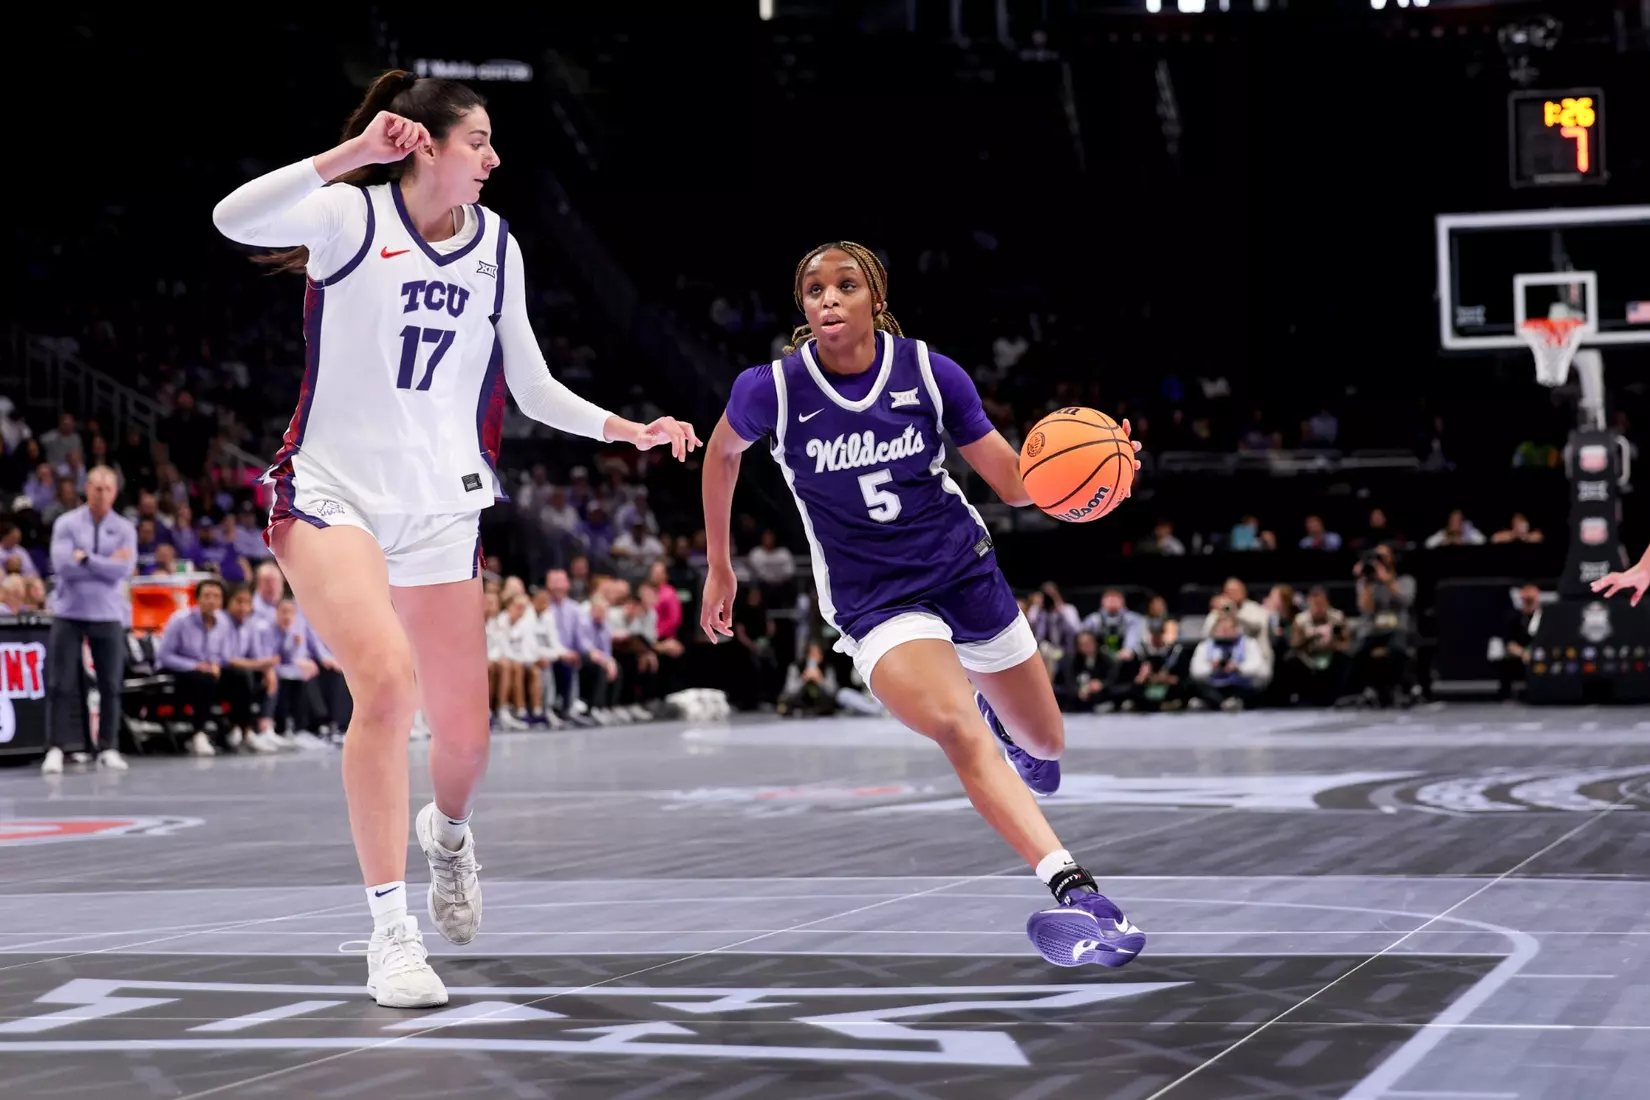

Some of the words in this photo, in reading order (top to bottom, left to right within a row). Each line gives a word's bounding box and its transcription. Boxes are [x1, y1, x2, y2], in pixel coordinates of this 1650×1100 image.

[400, 280, 470, 319] TCU
[396, 325, 456, 391] 17
[806, 423, 925, 474] Wildcats
[857, 468, 902, 523] 5
[0, 646, 42, 696] NT
